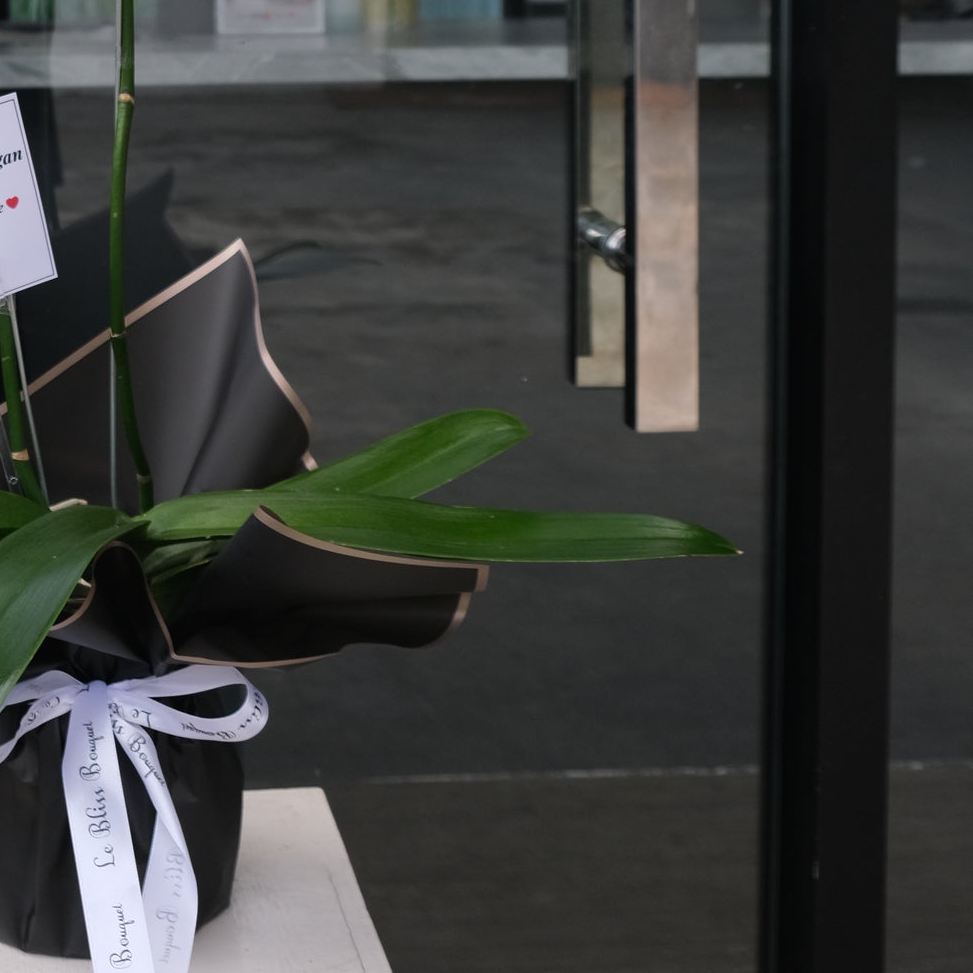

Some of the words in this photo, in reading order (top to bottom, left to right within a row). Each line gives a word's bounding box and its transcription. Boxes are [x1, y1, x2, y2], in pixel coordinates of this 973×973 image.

[79, 720, 104, 782] Bouquet
[85, 787, 111, 839] Bliss
[93, 843, 115, 868] Le
[109, 902, 135, 969] Bouquet
